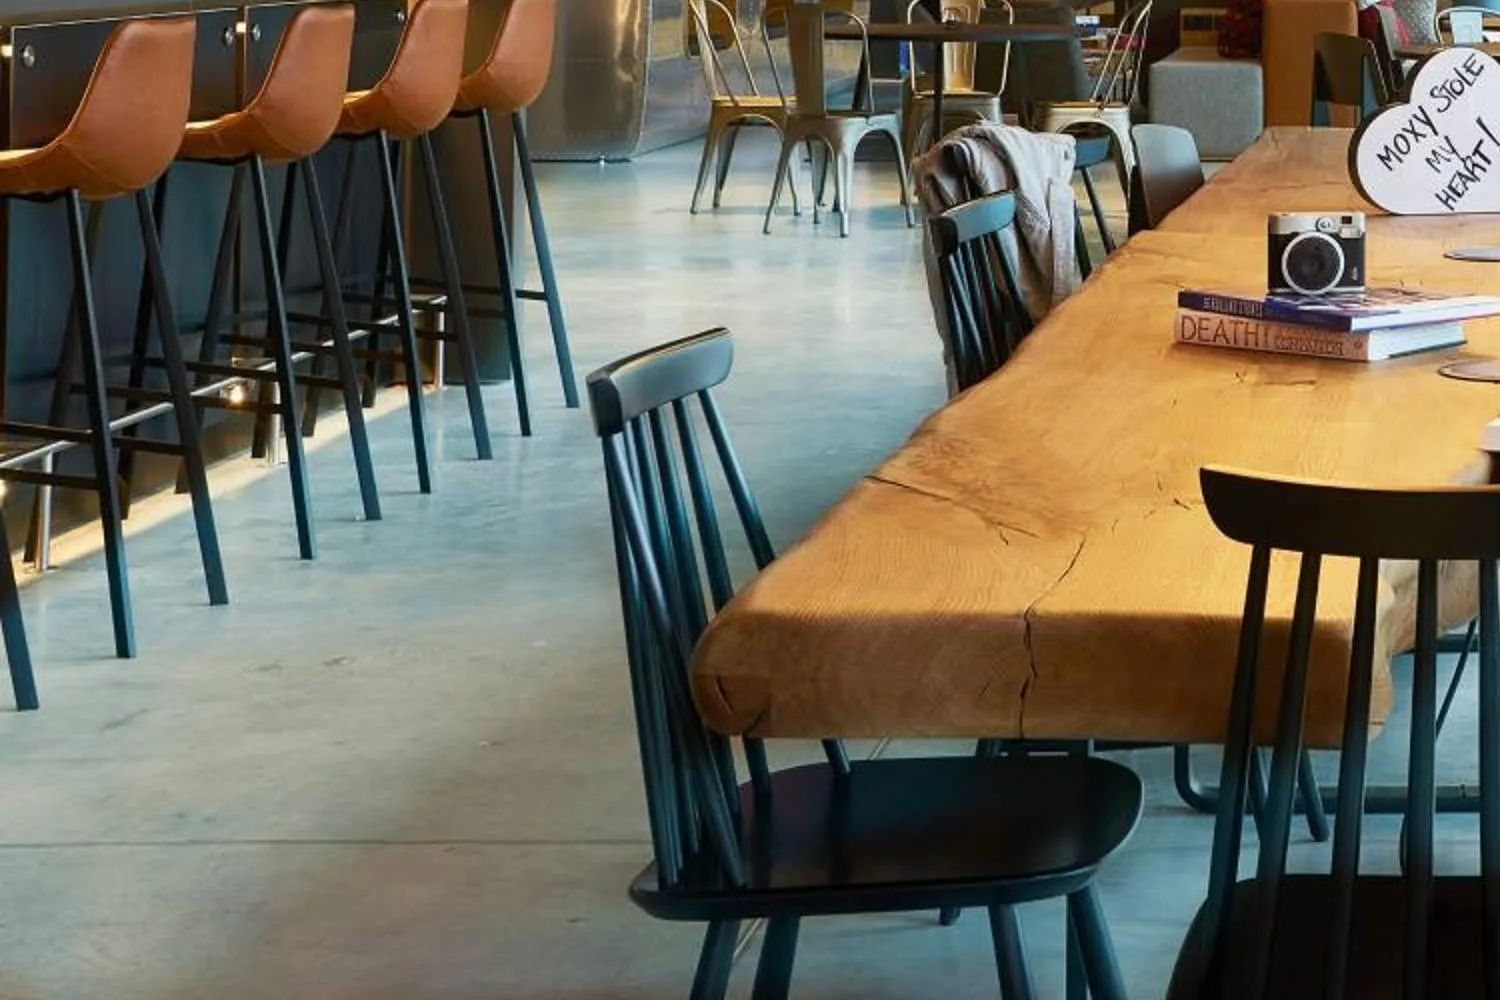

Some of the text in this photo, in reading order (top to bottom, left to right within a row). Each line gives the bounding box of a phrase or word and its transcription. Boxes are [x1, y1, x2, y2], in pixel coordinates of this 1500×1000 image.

[1376, 53, 1484, 171] MOXY STOLE
[1425, 136, 1466, 174] MY
[1180, 314, 1260, 348] DEATH
